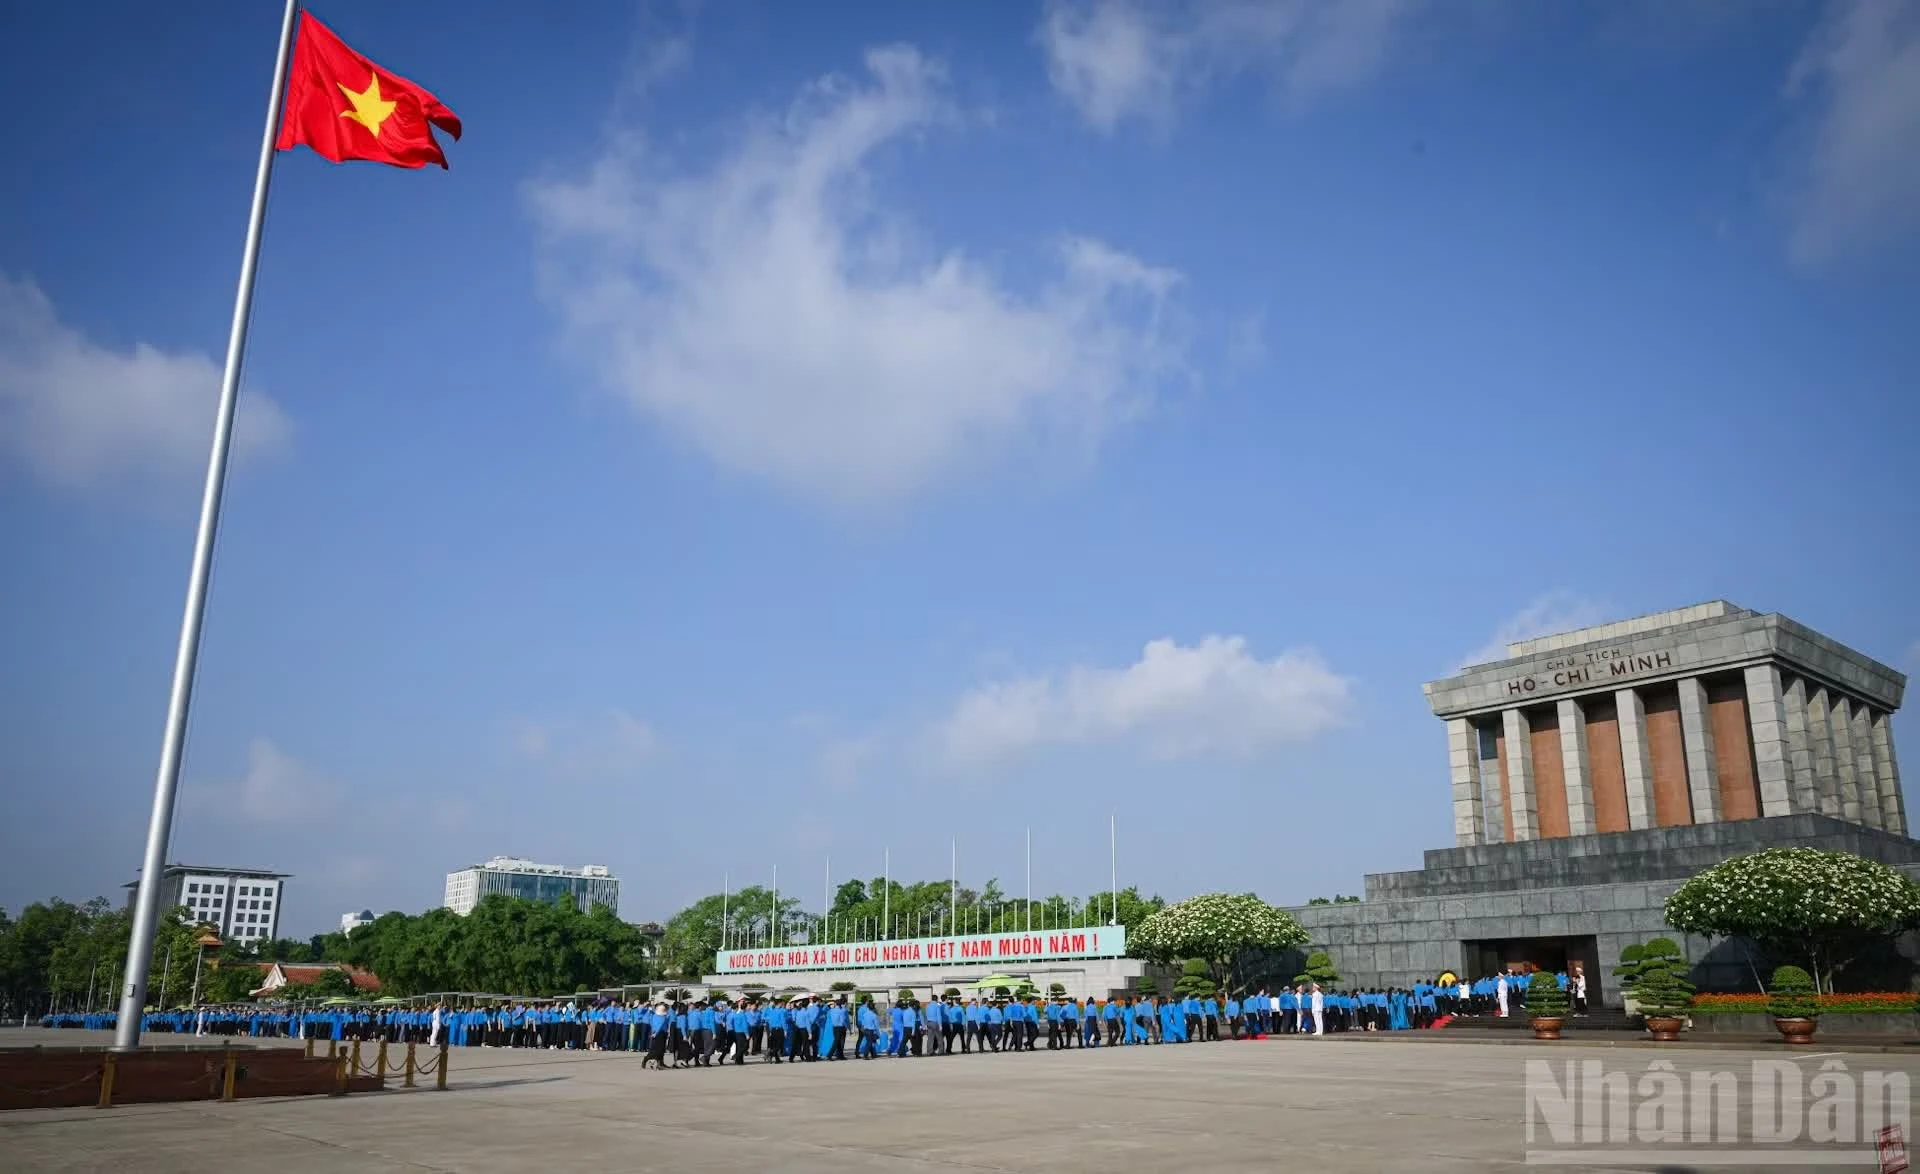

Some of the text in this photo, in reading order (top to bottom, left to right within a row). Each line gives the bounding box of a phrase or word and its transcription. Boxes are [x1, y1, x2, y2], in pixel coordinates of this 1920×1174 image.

[832, 946, 850, 966] HỘI
[883, 942, 920, 961] NGHĨA
[927, 939, 955, 961] VIỆT
[961, 940, 992, 956] NAM
[999, 934, 1043, 955] MUÔN
[1050, 932, 1085, 953] NĂM
